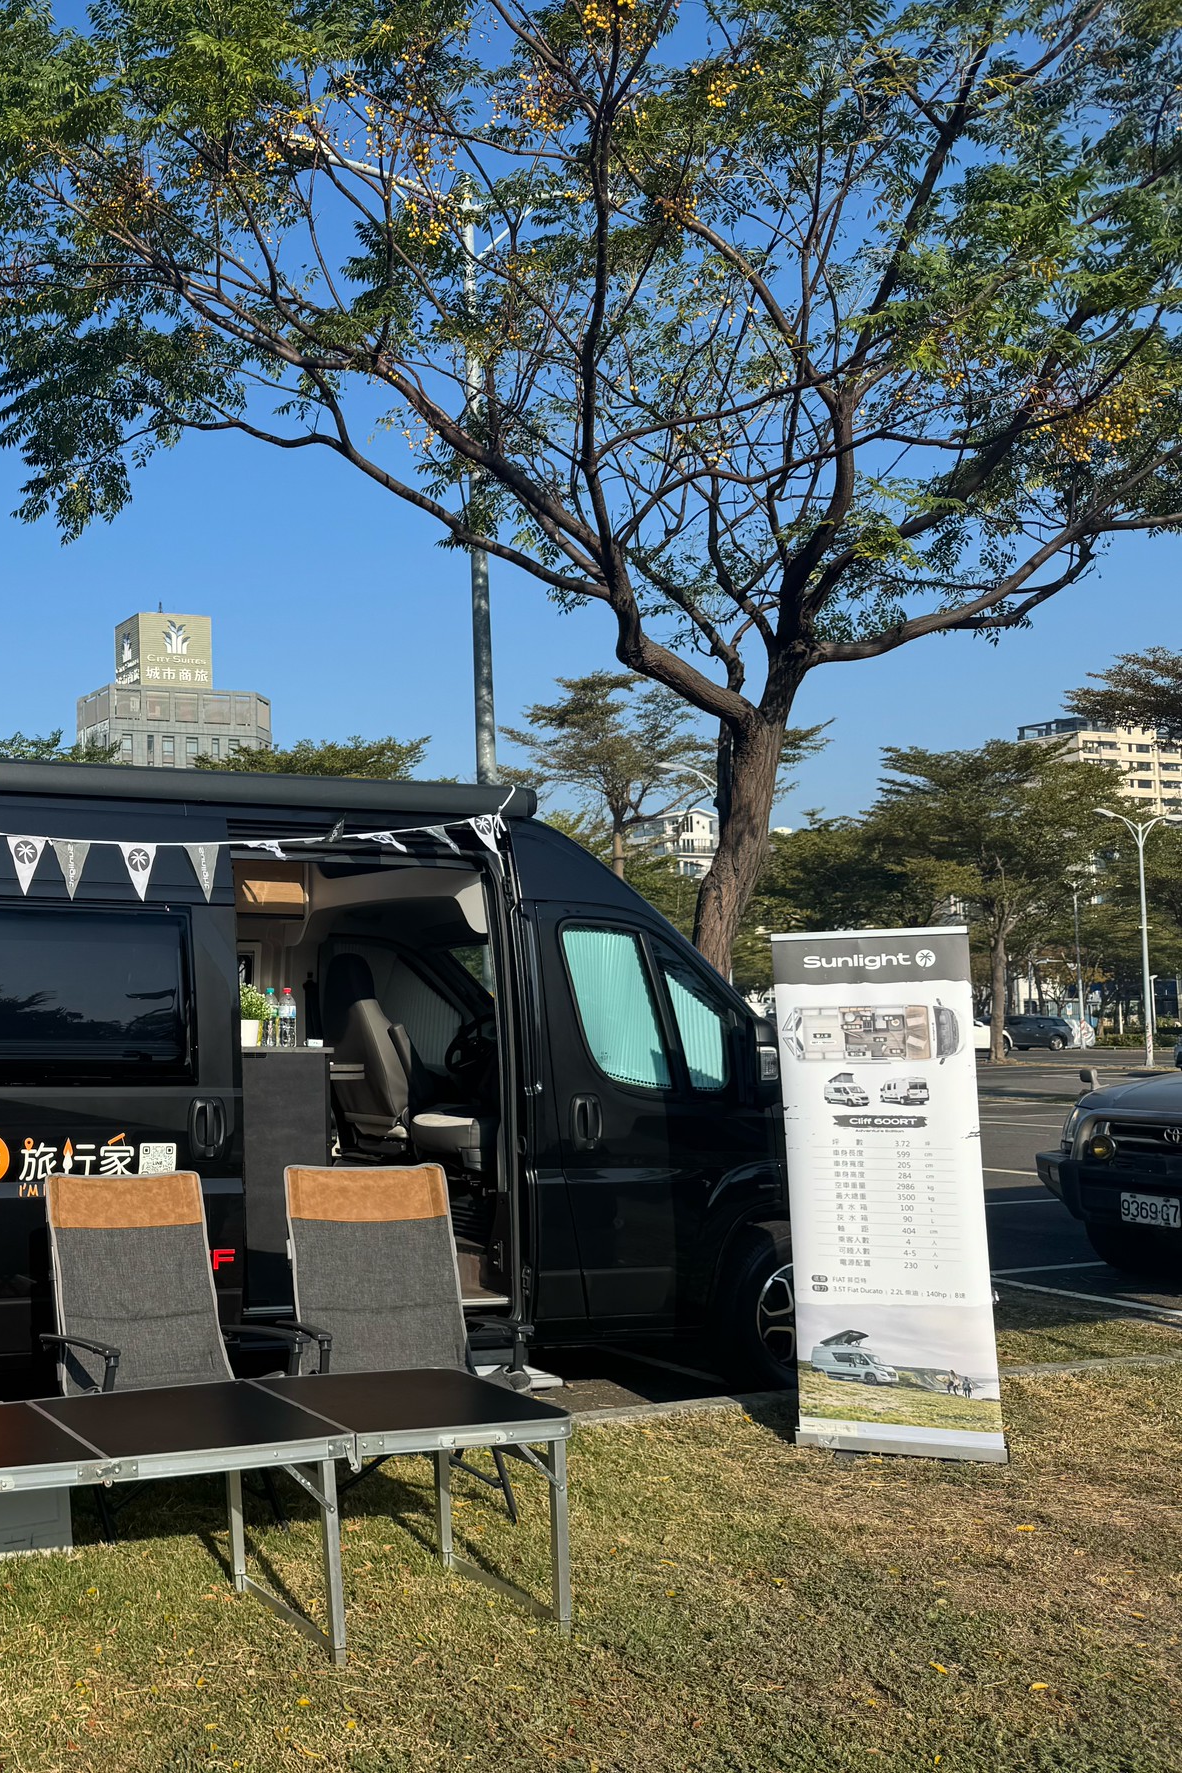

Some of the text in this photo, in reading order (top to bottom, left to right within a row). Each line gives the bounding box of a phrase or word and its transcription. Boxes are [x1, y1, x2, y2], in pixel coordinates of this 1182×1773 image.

[146, 654, 207, 665] CITY SUITES
[145, 666, 209, 683] 城市商旅
[803, 952, 912, 970] Sunlight
[849, 1117, 918, 1126] Cliff 600RT
[894, 1140, 911, 1148] 3.72
[18, 1134, 135, 1181] 旅行家
[896, 1150, 911, 1159] 599
[897, 1161, 912, 1169] 205
[897, 1172, 912, 1180] 284
[896, 1182, 916, 1191] 2986
[926, 1184, 935, 1192] kg
[897, 1193, 916, 1202] 3500
[927, 1195, 936, 1203] kg
[900, 1204, 915, 1212] 100
[902, 1215, 913, 1223] 90
[901, 1227, 917, 1235] 404
[905, 1238, 911, 1246] 4
[903, 1249, 917, 1257] 4-5
[903, 1261, 919, 1270] 230
